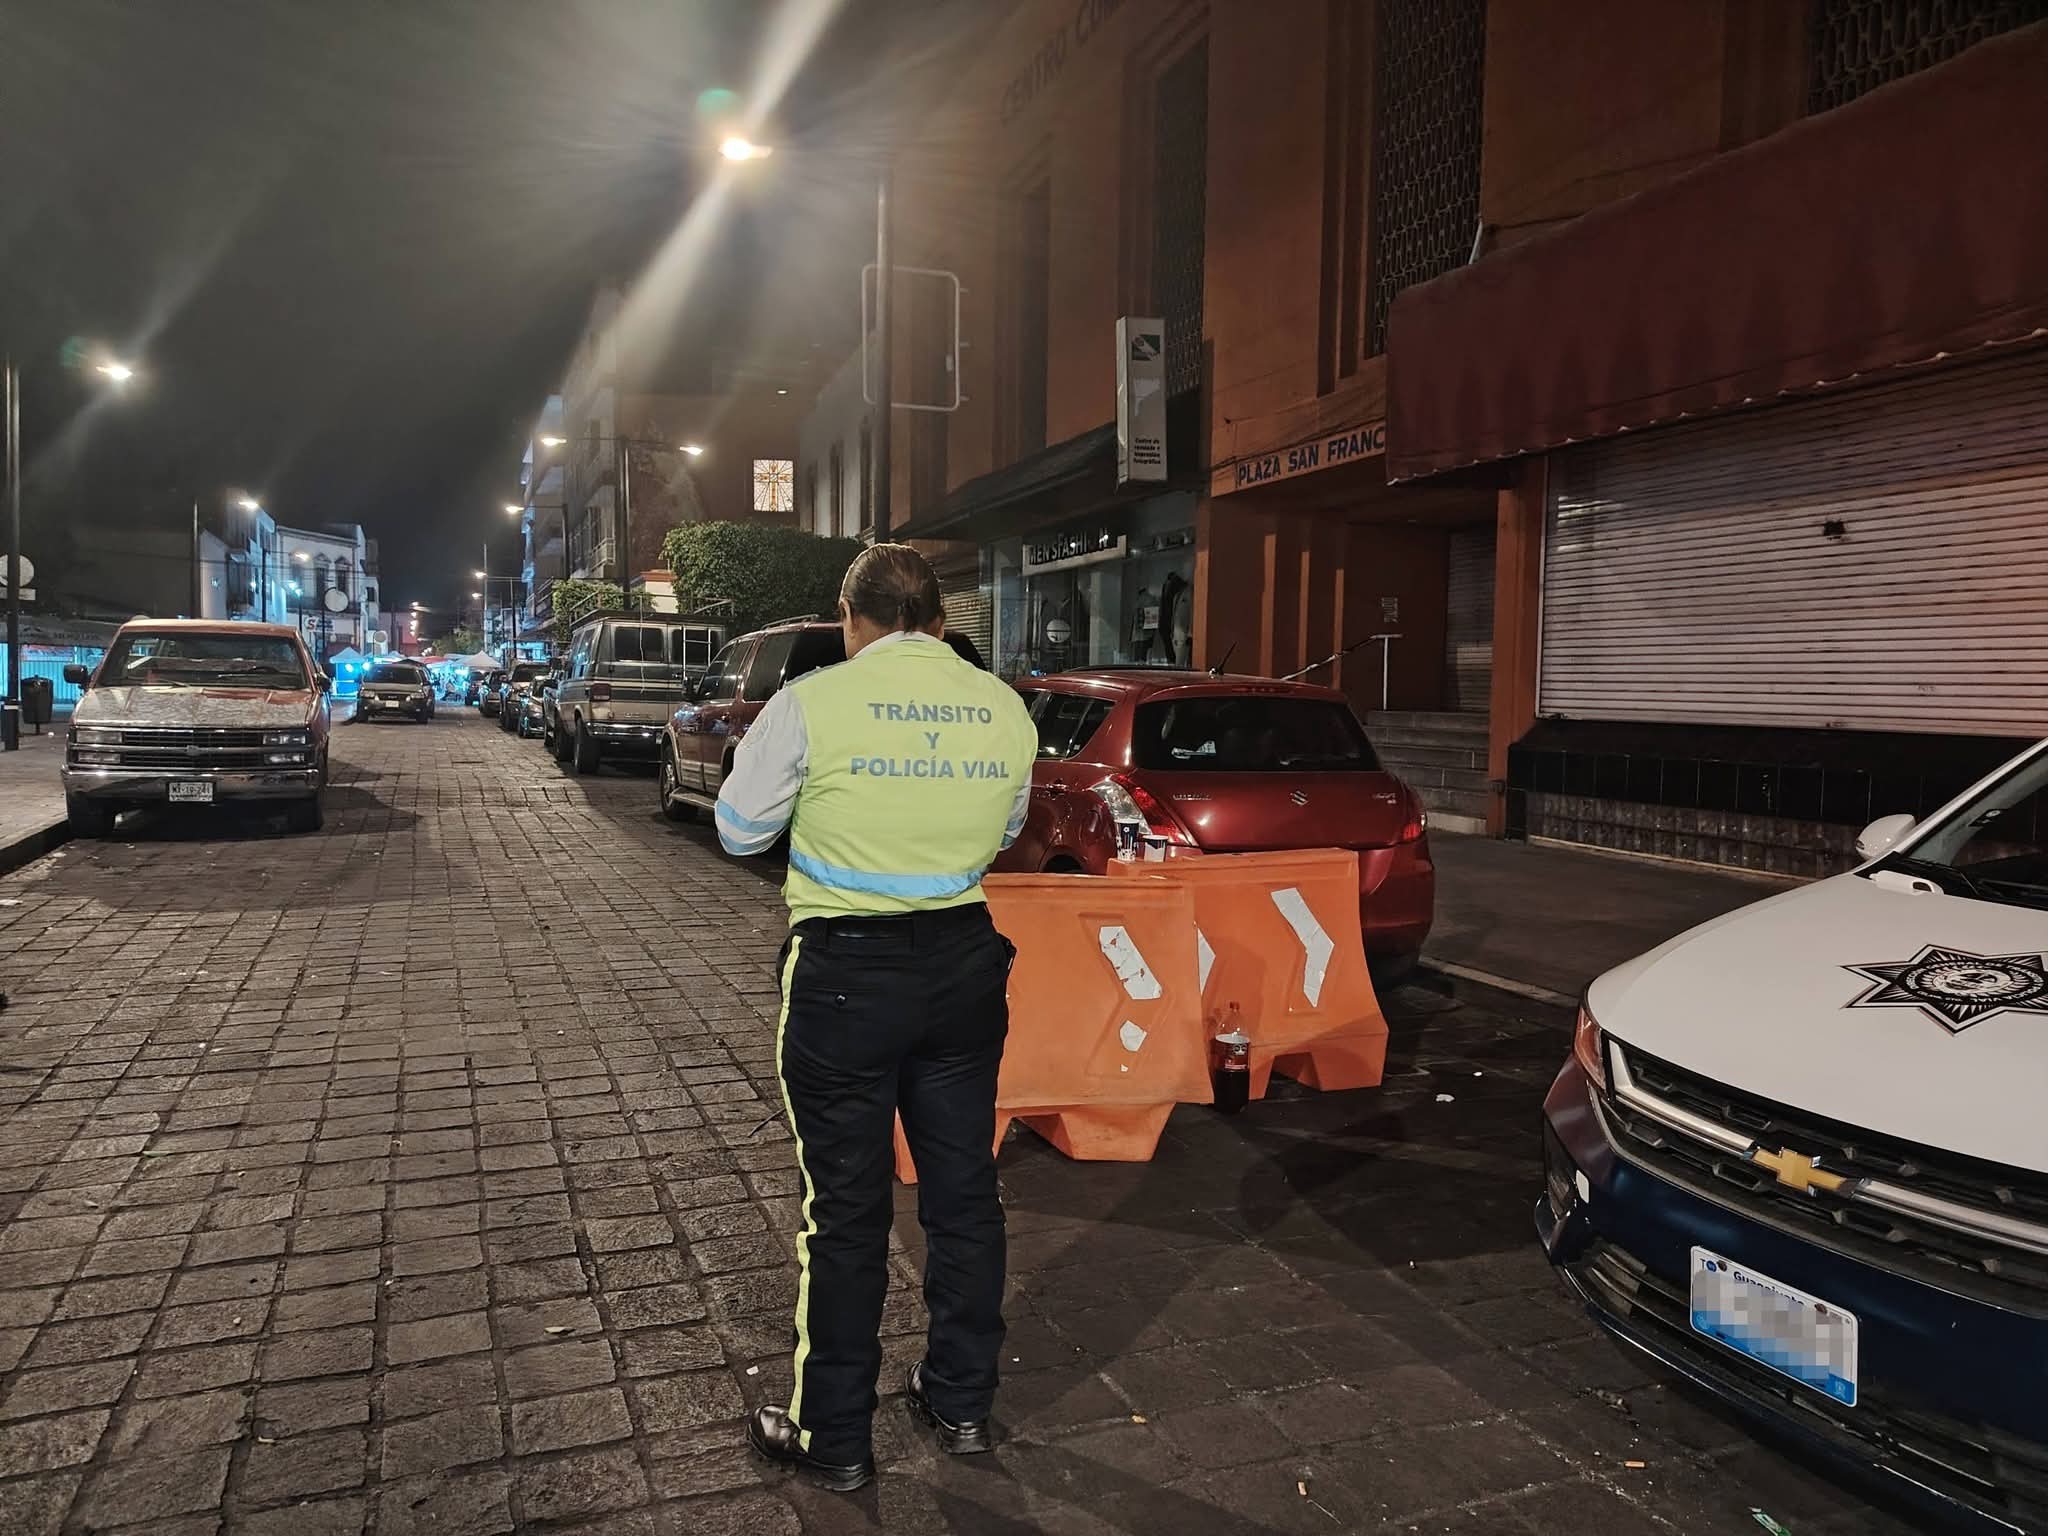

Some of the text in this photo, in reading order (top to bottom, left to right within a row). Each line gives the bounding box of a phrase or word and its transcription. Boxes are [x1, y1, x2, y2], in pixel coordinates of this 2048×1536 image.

[1238, 454, 1281, 486] PLAZA
[1288, 444, 1319, 472] SAN
[867, 699, 992, 724] TRÁNSITO
[924, 732, 940, 750] Y
[850, 755, 1009, 779] POLICÍA VIAL
